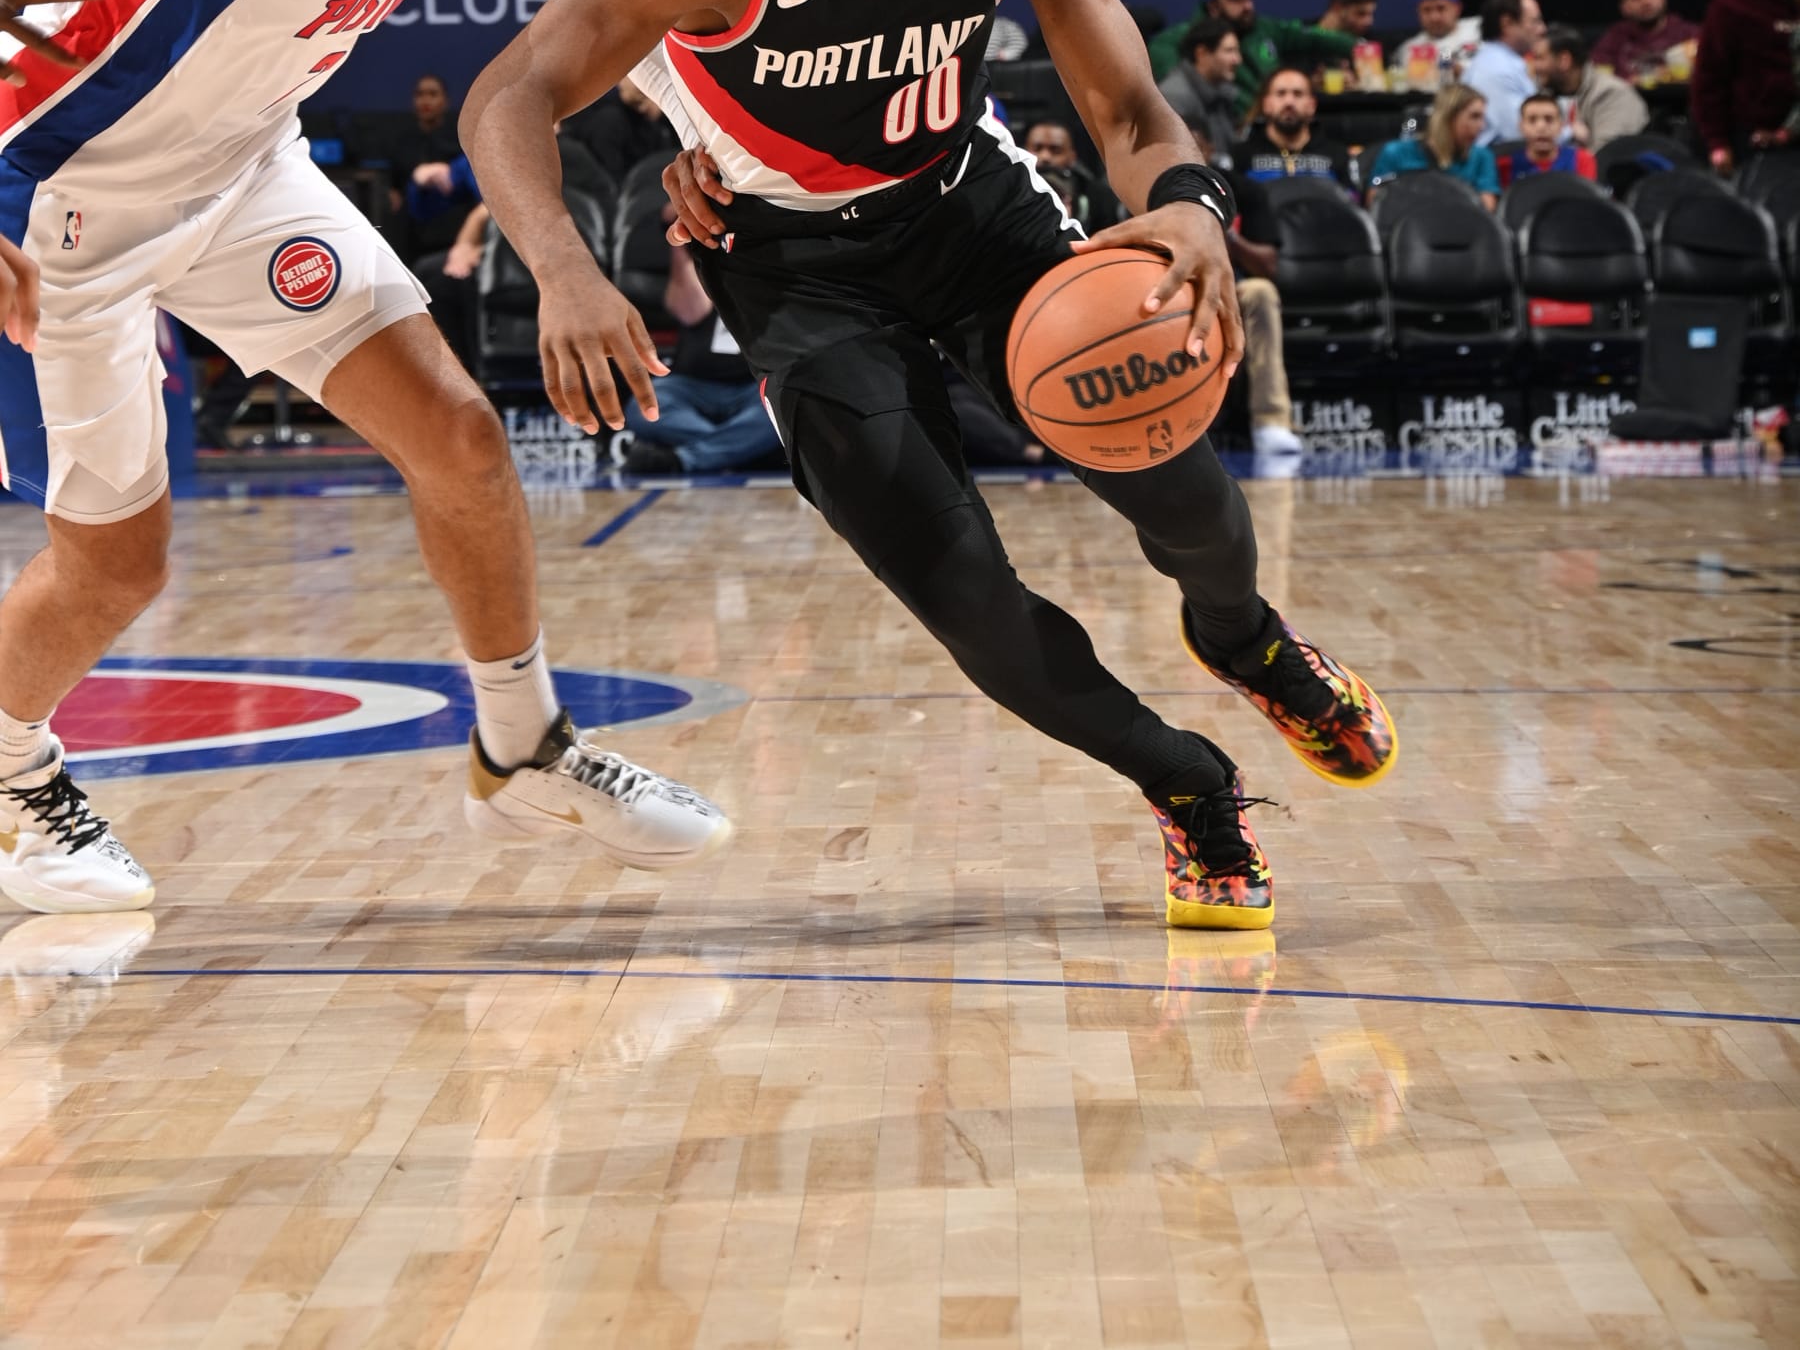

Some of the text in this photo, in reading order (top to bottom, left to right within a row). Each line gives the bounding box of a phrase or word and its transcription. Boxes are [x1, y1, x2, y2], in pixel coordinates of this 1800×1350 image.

[753, 14, 985, 88] PORTLAND
[883, 55, 961, 144] 00
[280, 254, 323, 282] DETROIT
[285, 264, 329, 294] PISTONS
[1421, 395, 1504, 428] Little
